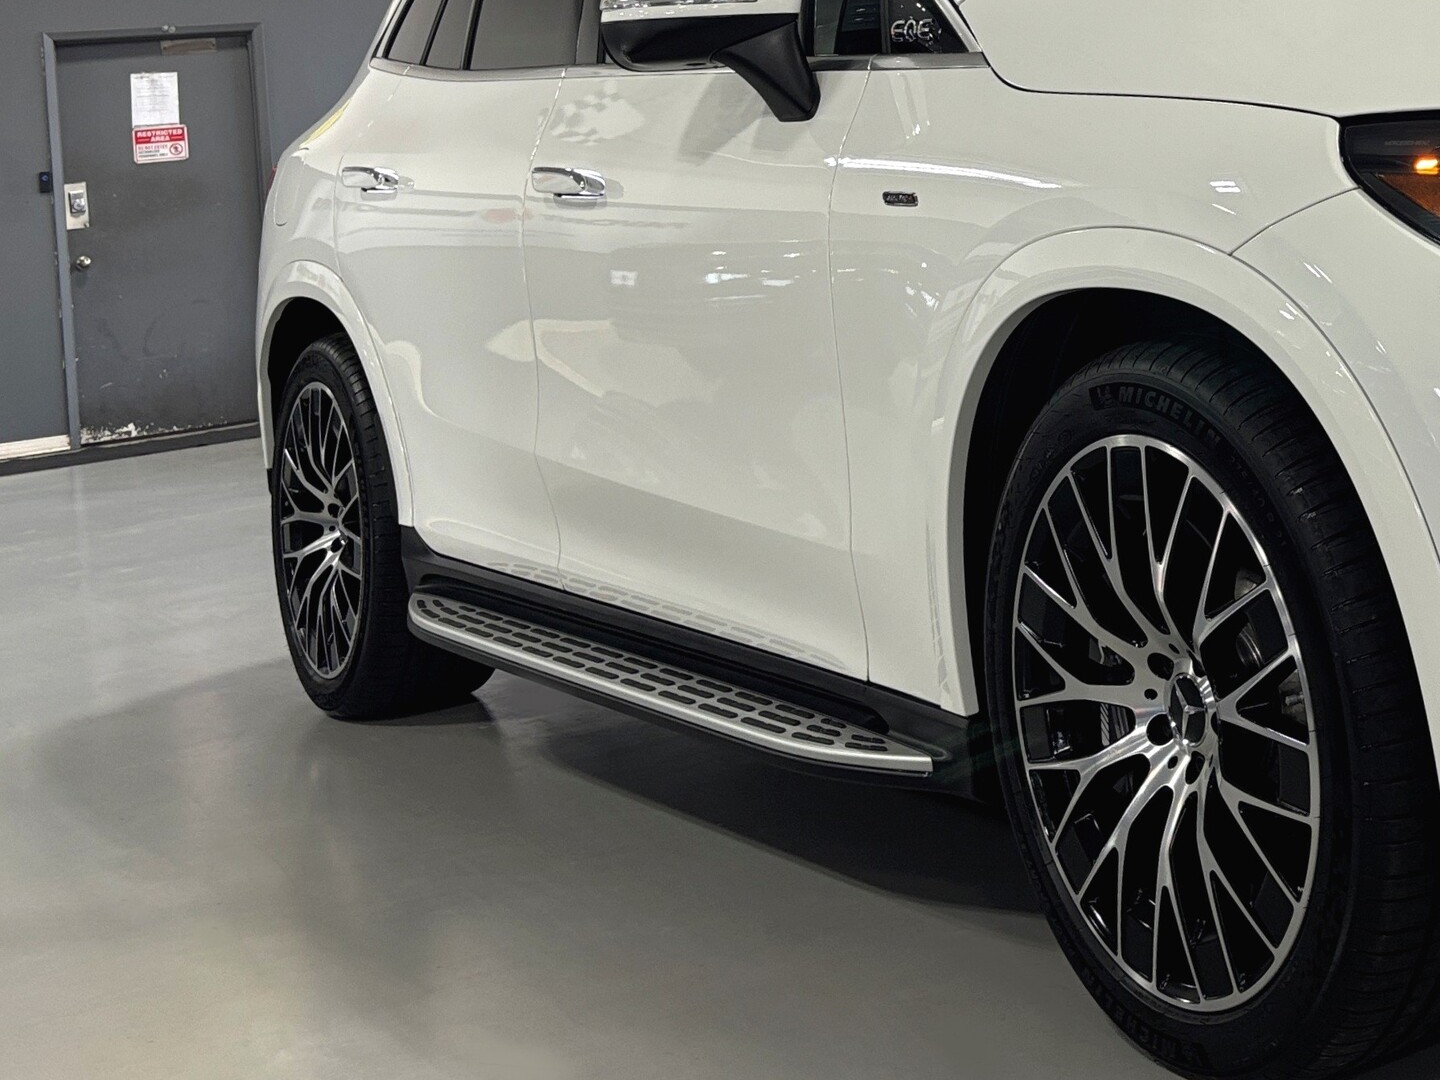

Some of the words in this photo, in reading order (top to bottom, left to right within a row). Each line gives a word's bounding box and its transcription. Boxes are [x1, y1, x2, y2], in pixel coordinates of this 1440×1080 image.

[137, 129, 183, 137] RESTRICTED
[150, 135, 170, 143] AREA
[1119, 385, 1222, 445] MICHELIN
